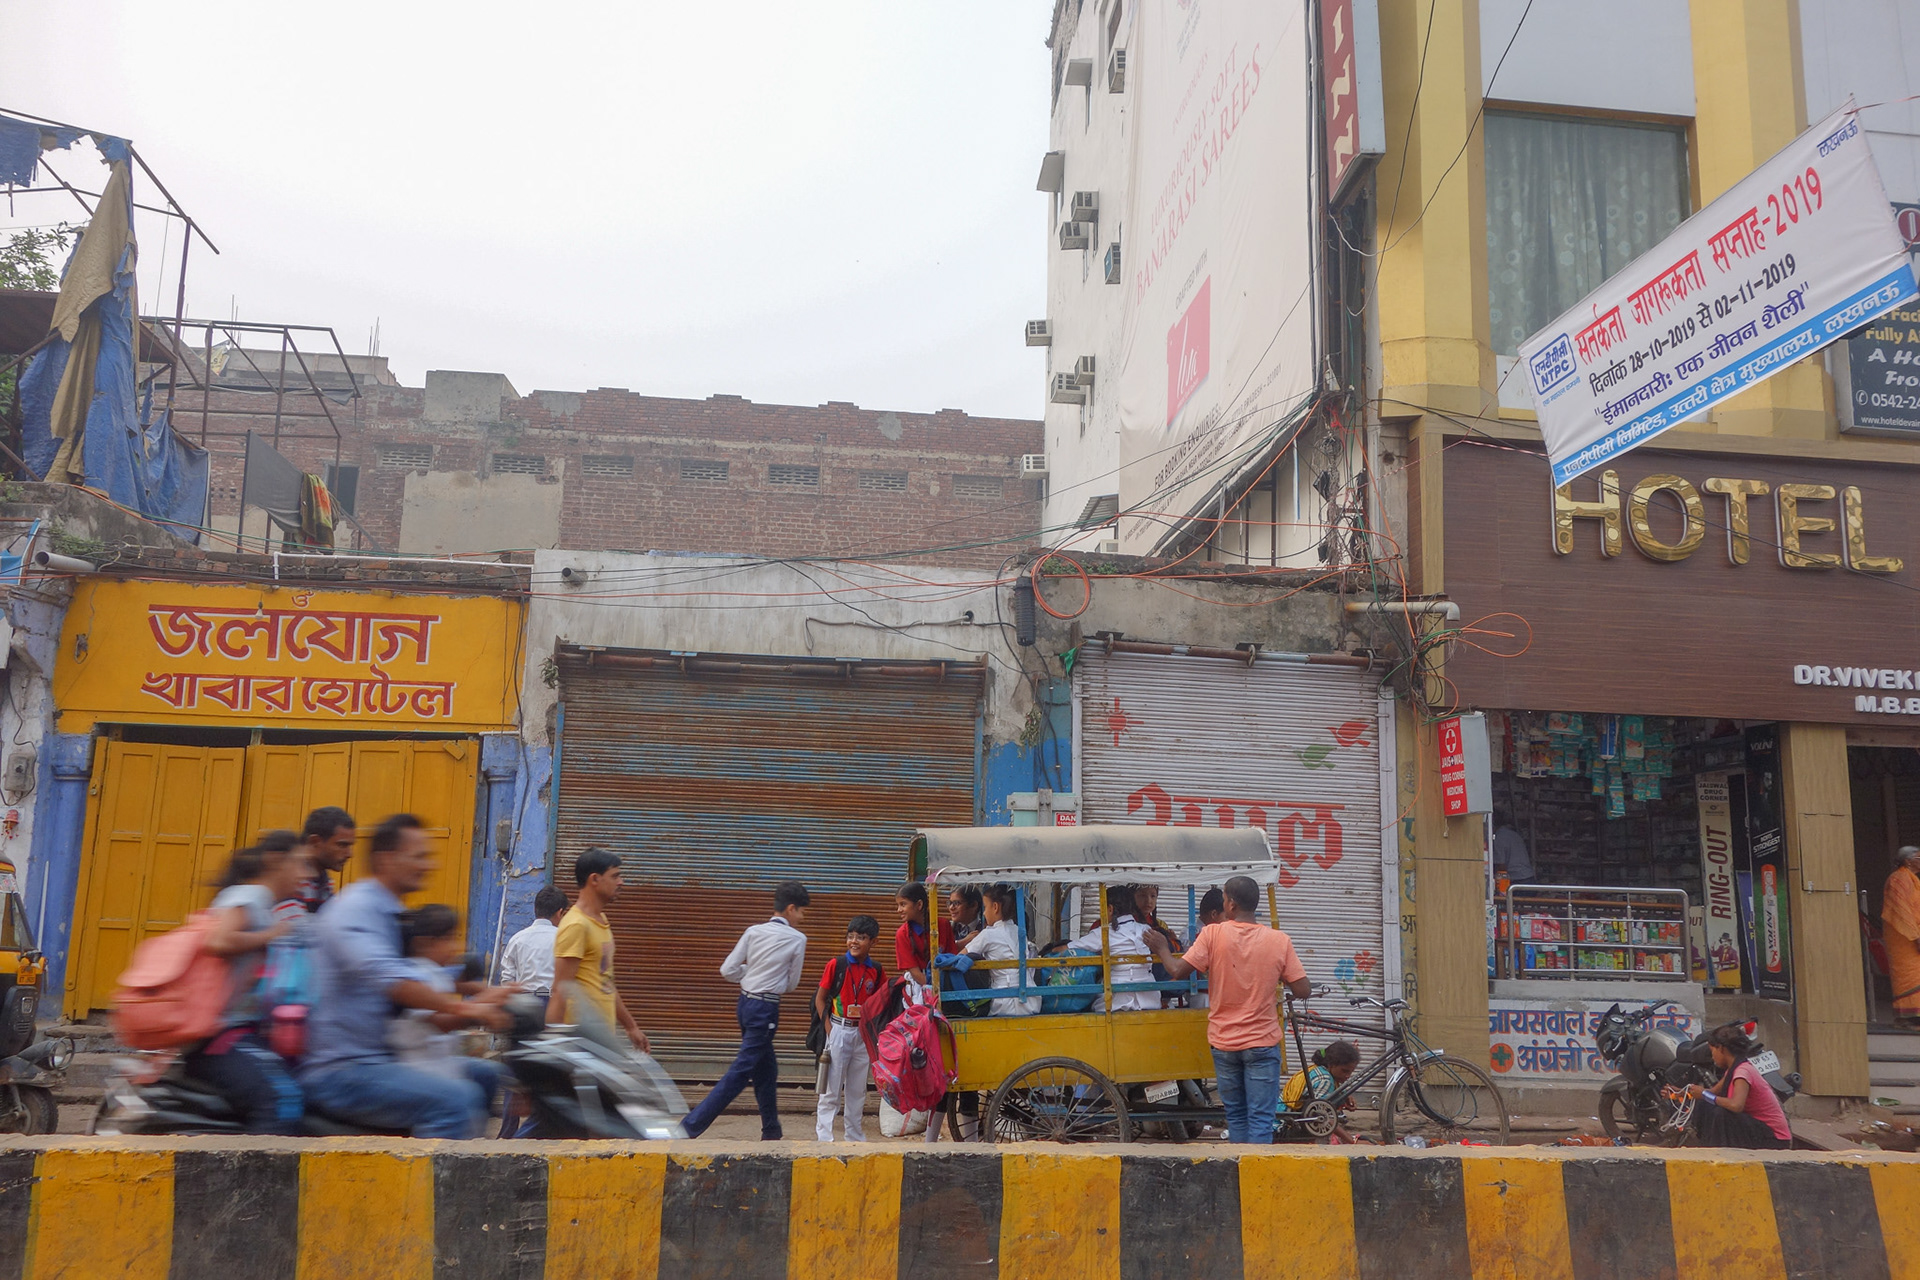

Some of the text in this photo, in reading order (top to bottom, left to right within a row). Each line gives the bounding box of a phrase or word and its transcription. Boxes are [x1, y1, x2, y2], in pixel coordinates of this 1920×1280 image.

[1151, 100, 1208, 233] LUXURIOUSLY
[1210, 42, 1237, 116] SOFT
[1817, 119, 1858, 158] लखनऊ
[1137, 42, 1260, 306] BANARASI SAREES
[1707, 167, 1823, 274] सप्ताह-2019
[1589, 253, 1796, 397] दिनांक 28-10-2019 से 02-11-2019
[1675, 351, 1705, 381] एक
[1706, 320, 1759, 360] जीवन
[1535, 340, 1568, 376] एनटीपीसी
[1540, 359, 1570, 388] NTPC
[1563, 433, 1616, 477] एनटीपीसी
[1615, 411, 1667, 448] लिमिटेड,
[1710, 371, 1737, 396] क्षेत्र
[1737, 328, 1822, 384] मुख्यालय,
[1822, 280, 1900, 334] लखनऊ
[1868, 348, 1887, 363] A
[1165, 441, 1187, 479] BOOKING
[1551, 469, 1903, 574] HOTEL
[148, 604, 441, 665] জলযোগ
[140, 664, 457, 718] খাবার হোটেল
[1447, 785, 1464, 797] MEDICINE
[1451, 800, 1461, 810] SHOP
[1705, 825, 1732, 920] RING-OUT
[1517, 1038, 1584, 1072] अंग्रेजी
